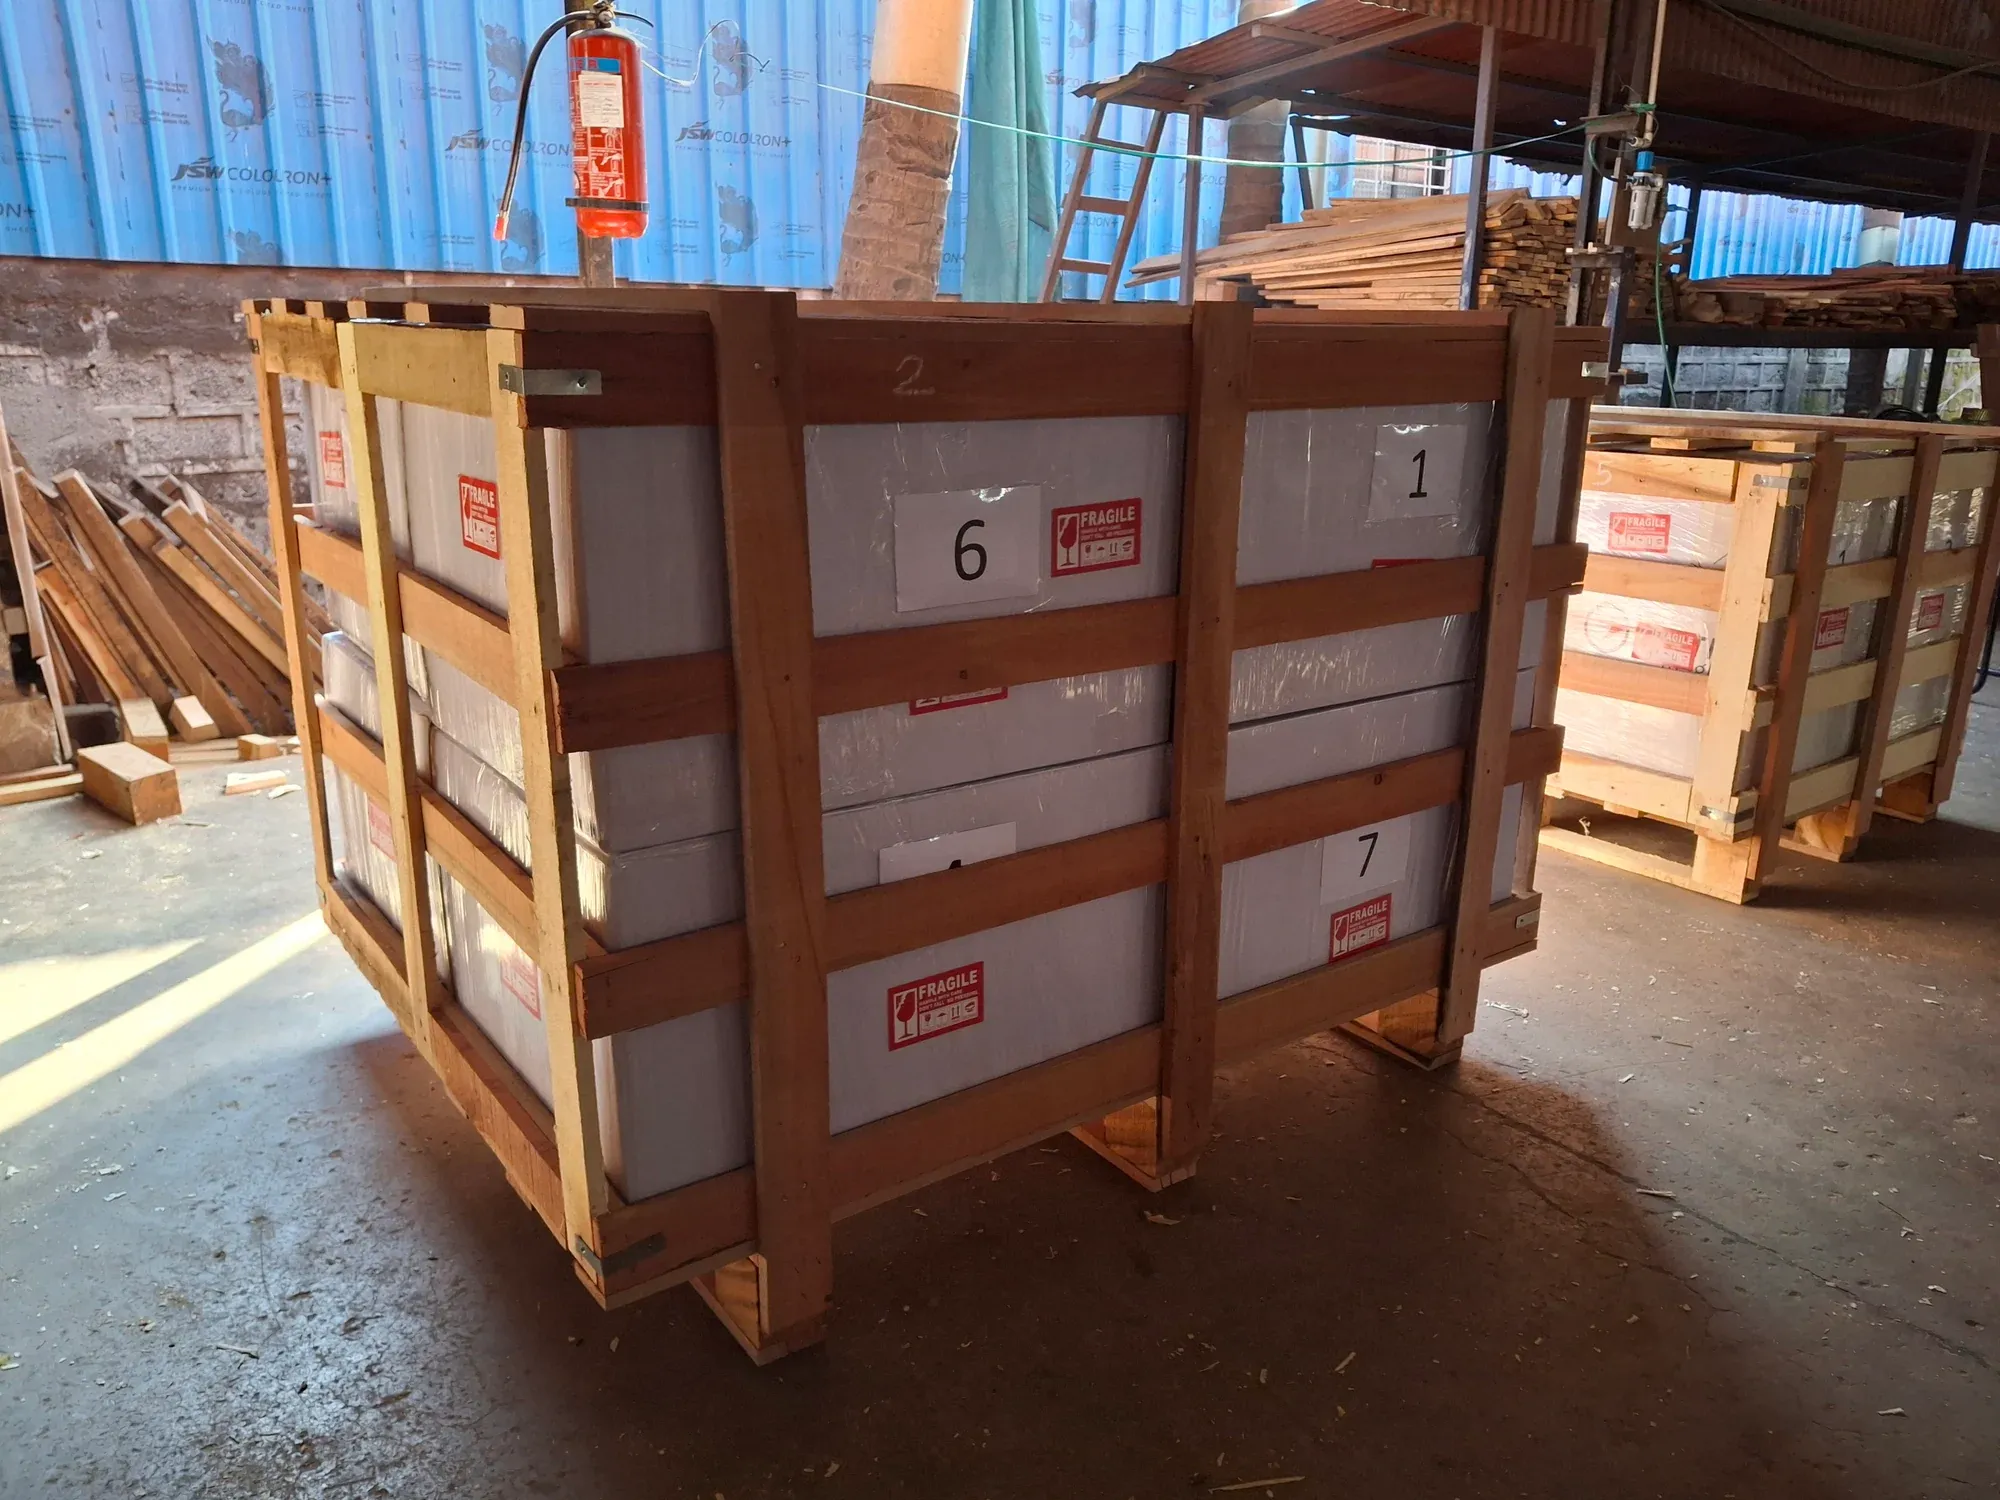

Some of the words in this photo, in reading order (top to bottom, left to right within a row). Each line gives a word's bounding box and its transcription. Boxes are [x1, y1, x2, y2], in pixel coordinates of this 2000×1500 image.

[674, 123, 714, 142] JSW
[171, 159, 225, 181] JSW
[892, 355, 936, 396] 2
[1409, 449, 1428, 498] 1
[1591, 463, 1613, 486] 5
[1080, 506, 1136, 528] FRAGILE
[1626, 517, 1667, 529] FRAGILE
[954, 519, 987, 581] 6
[1664, 630, 1695, 646] AGILE
[1358, 832, 1379, 877] 7
[1349, 899, 1388, 923] FRAGILE
[918, 969, 978, 999] FRAGILE
